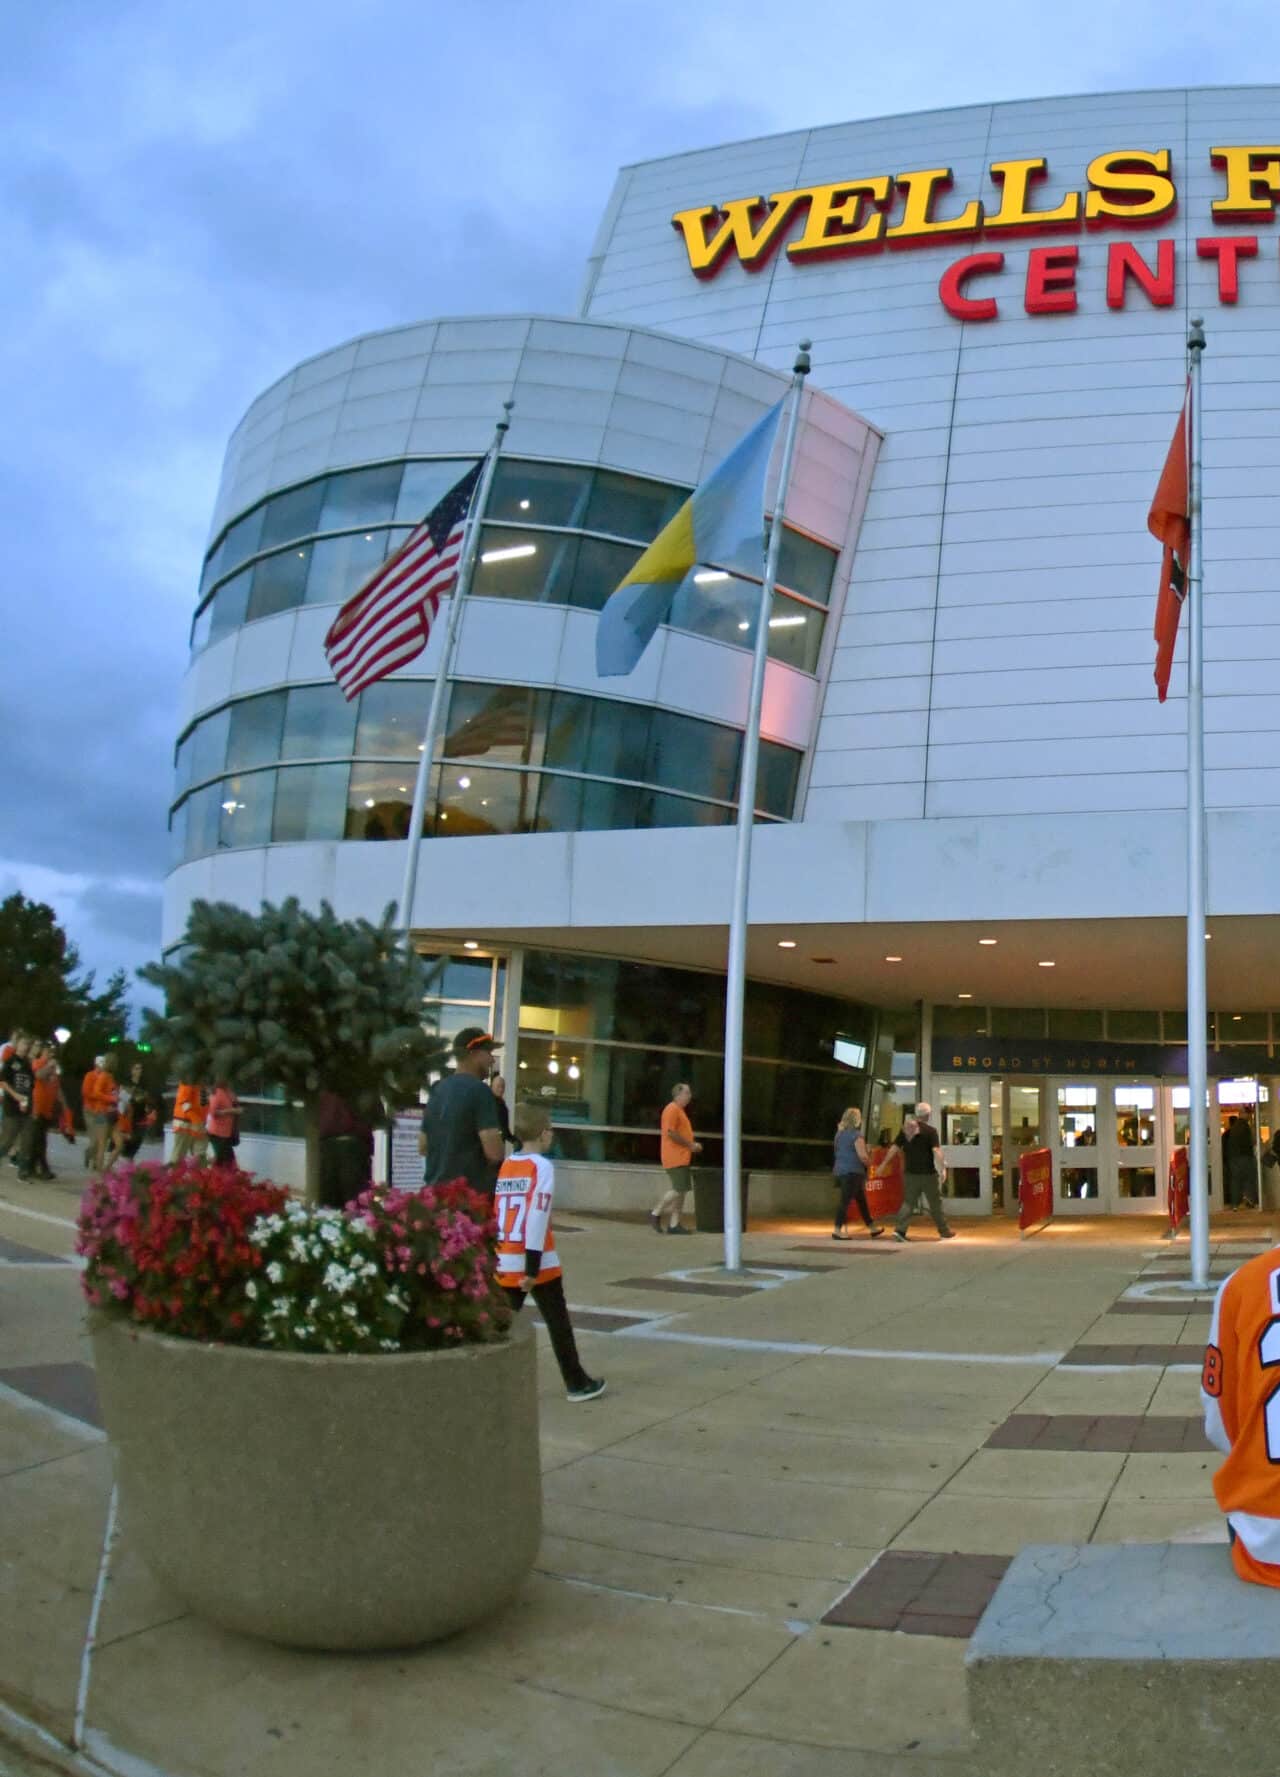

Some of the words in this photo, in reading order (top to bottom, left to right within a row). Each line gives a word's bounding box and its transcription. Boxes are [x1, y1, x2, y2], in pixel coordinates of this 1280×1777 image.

[671, 148, 1177, 280] WELLS
[952, 1055, 1022, 1069] BROAD
[497, 1194, 527, 1242] 17
